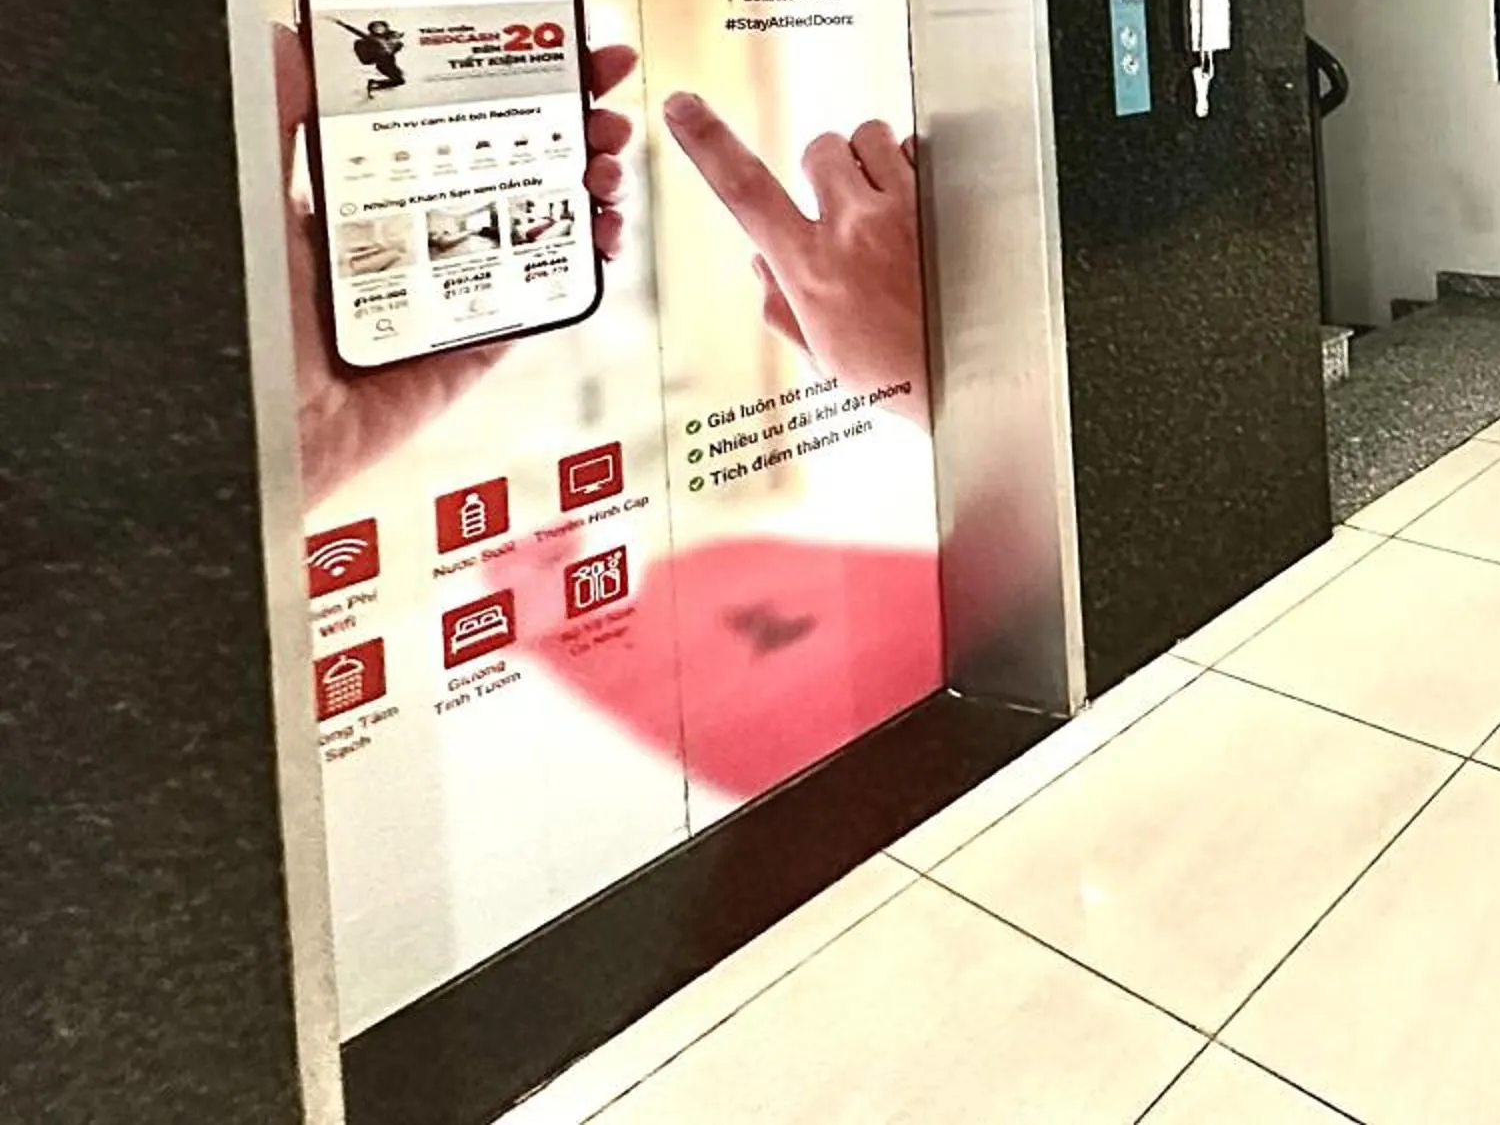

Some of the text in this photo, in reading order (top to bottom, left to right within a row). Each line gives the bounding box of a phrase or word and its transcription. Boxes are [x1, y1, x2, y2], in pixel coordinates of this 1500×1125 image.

[725, 14, 854, 32] #StayAtRedDoorz
[707, 407, 736, 429] Giá
[740, 398, 776, 419] luôn
[780, 388, 801, 407] tốt
[708, 432, 759, 458] Nhiều
[815, 404, 839, 421] khi
[841, 394, 866, 413] đặt
[869, 379, 913, 406] phòng
[709, 419, 874, 486] Tích điểm thành viên
